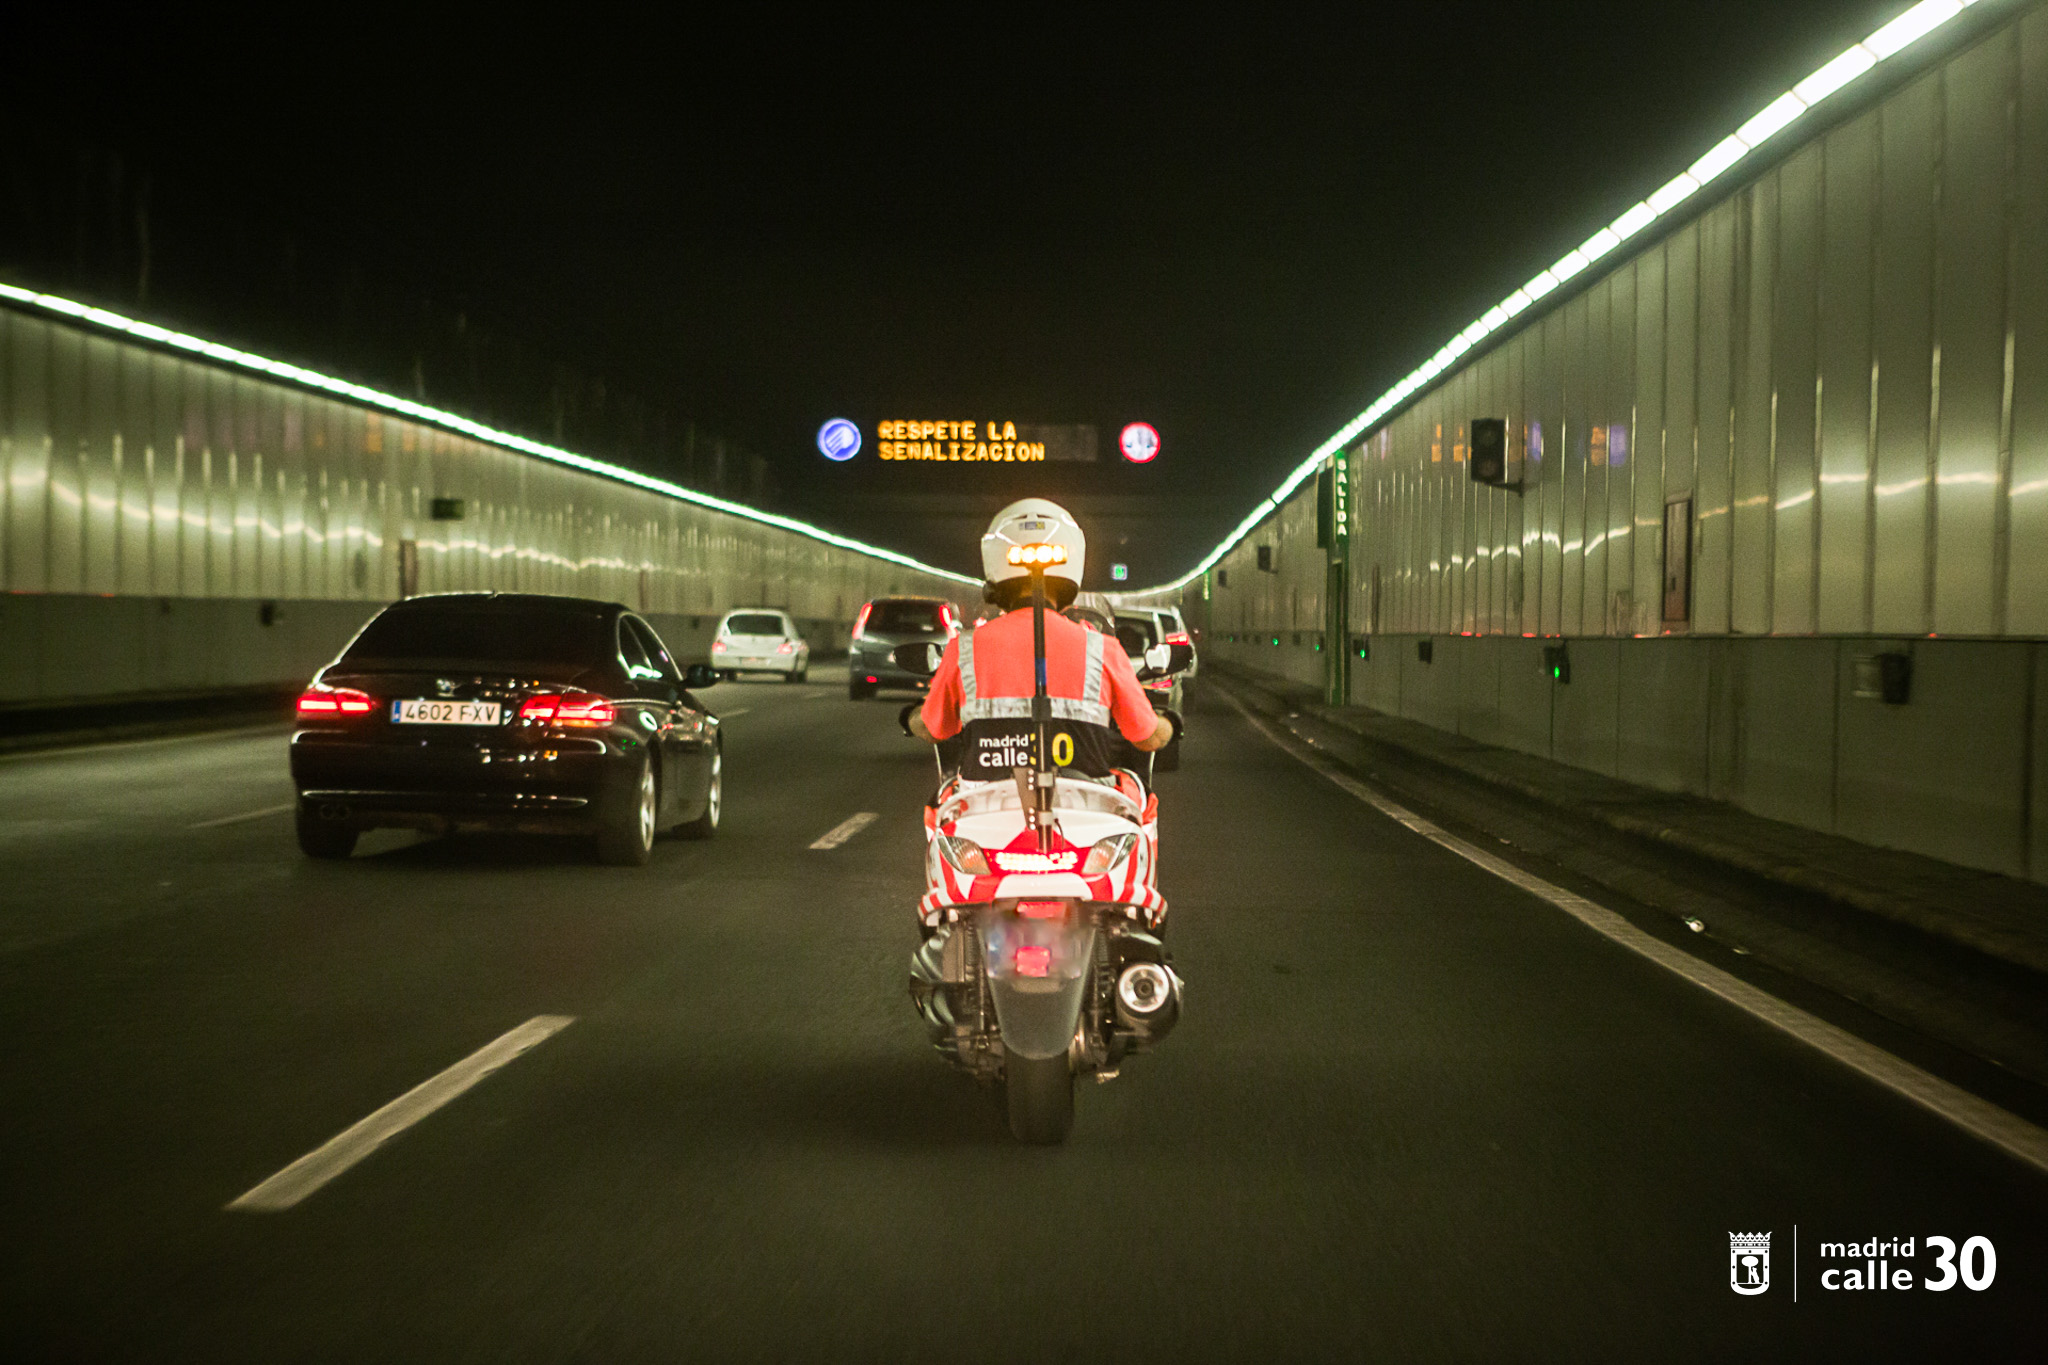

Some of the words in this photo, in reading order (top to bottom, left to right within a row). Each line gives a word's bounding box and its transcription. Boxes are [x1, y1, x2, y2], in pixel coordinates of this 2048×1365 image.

[878, 420, 976, 440] RESPETE
[987, 420, 1017, 440] LA
[1337, 459, 1347, 536] SALIDA
[405, 704, 453, 721] 4602
[459, 704, 496, 722] FXV
[979, 734, 1029, 747] madrid
[979, 748, 1028, 767] calle
